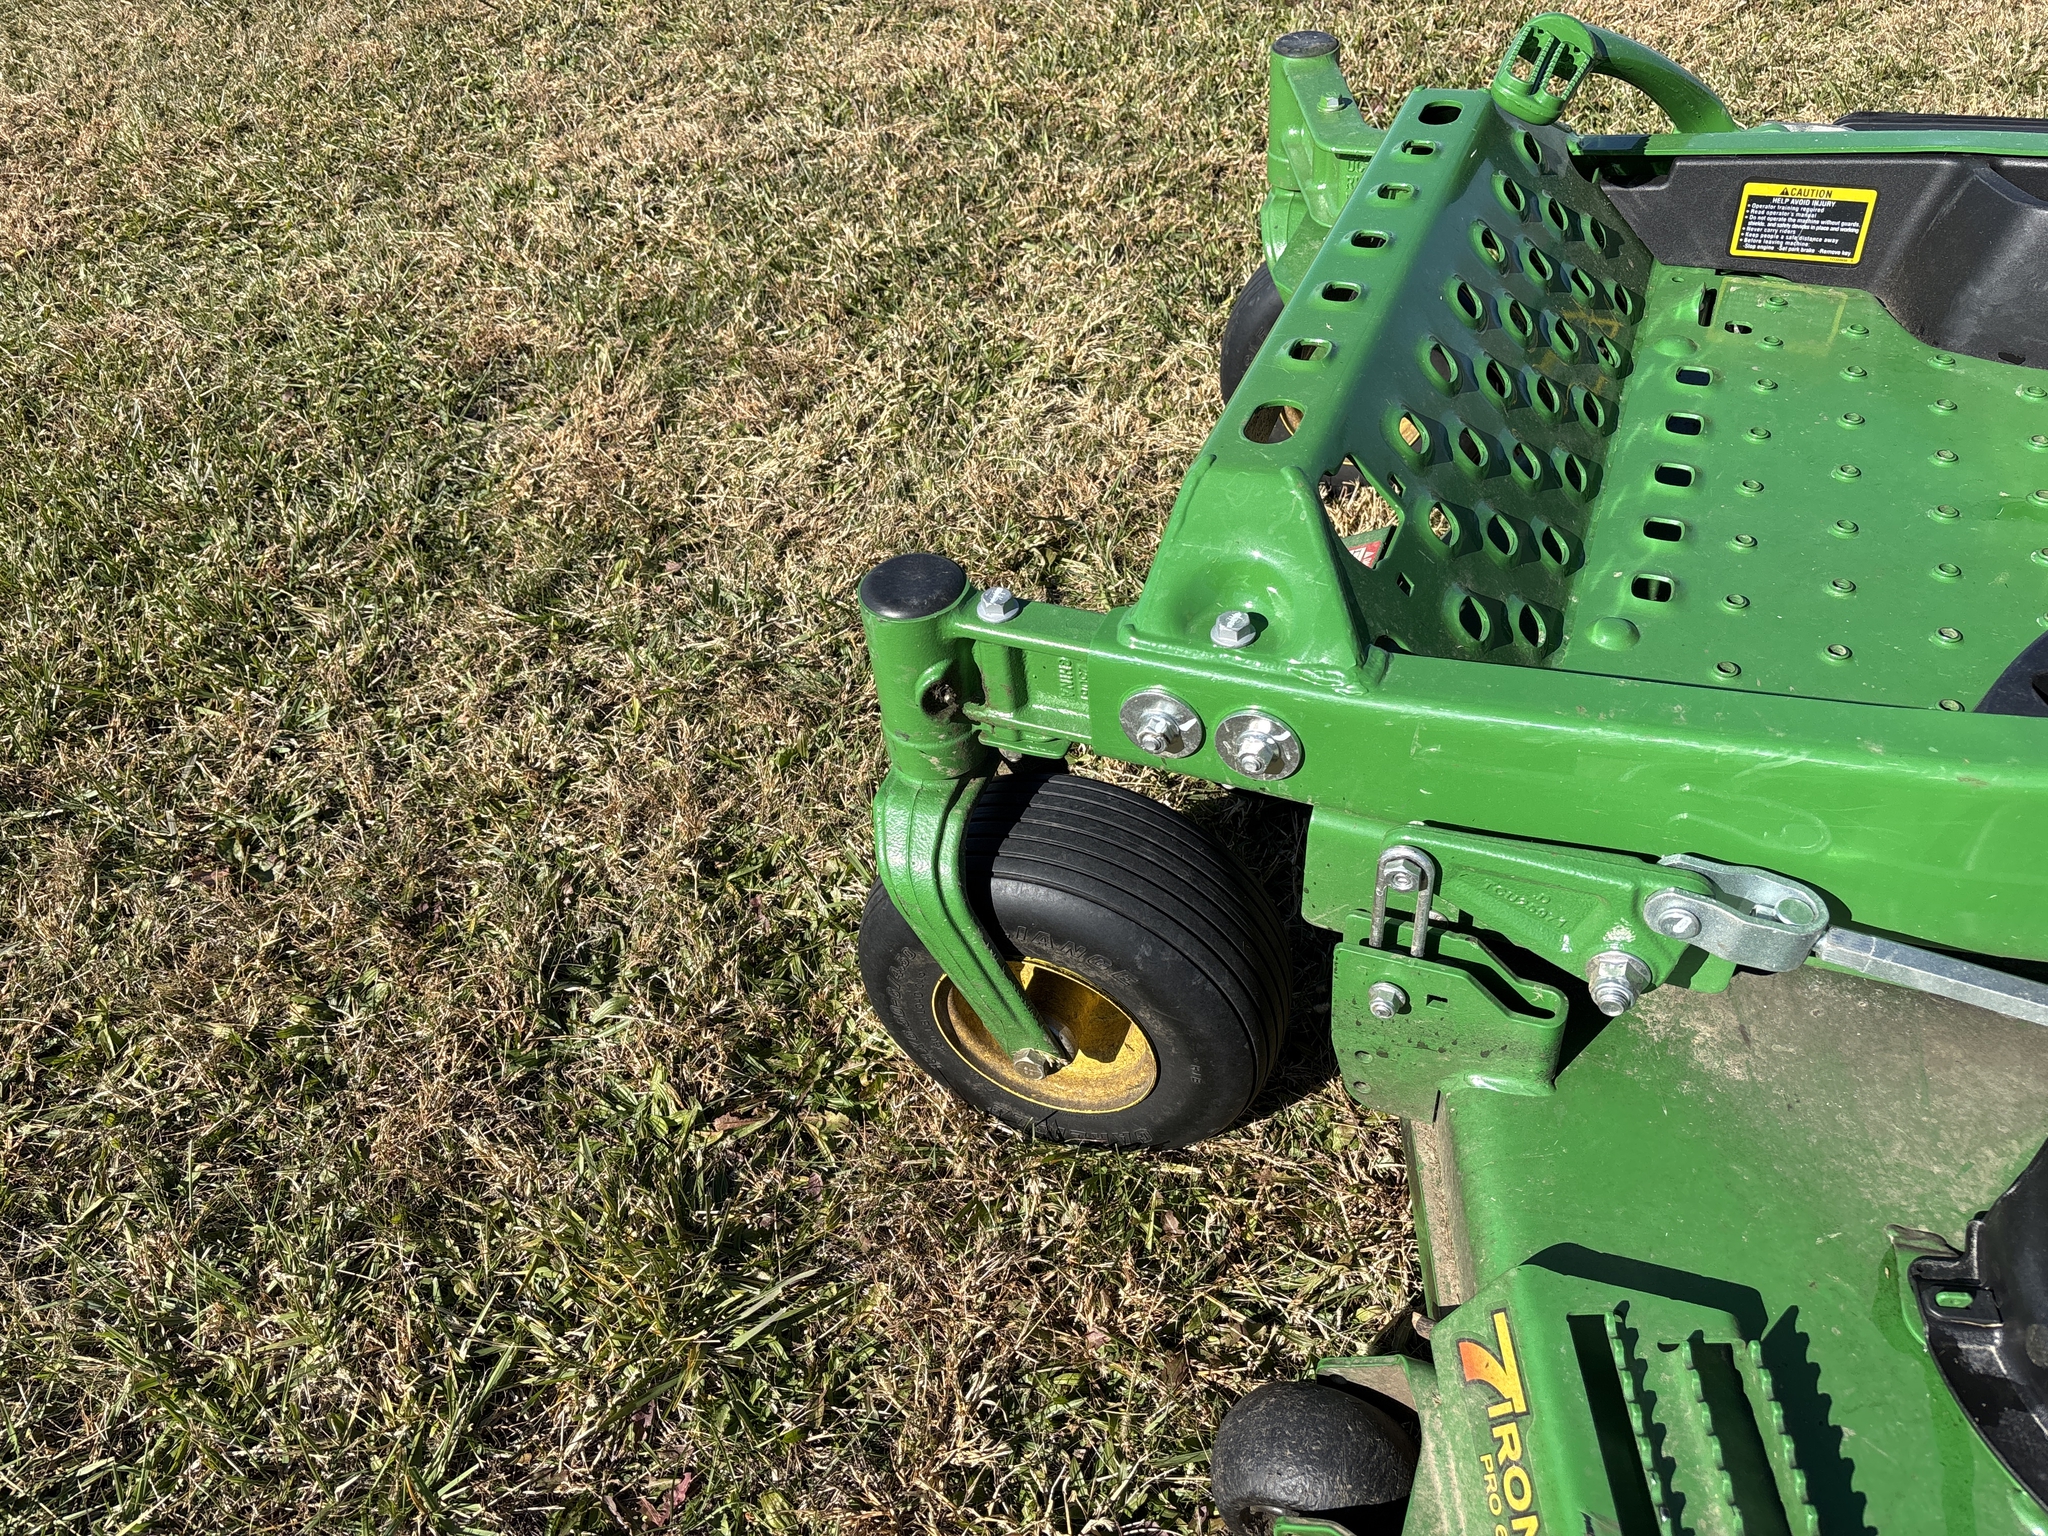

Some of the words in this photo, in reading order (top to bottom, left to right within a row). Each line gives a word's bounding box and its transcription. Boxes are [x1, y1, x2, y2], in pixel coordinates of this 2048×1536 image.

[1790, 188, 1833, 198] CAUTION
[1006, 925, 1139, 987] IANCE
[1479, 1453, 1503, 1517] PRO
